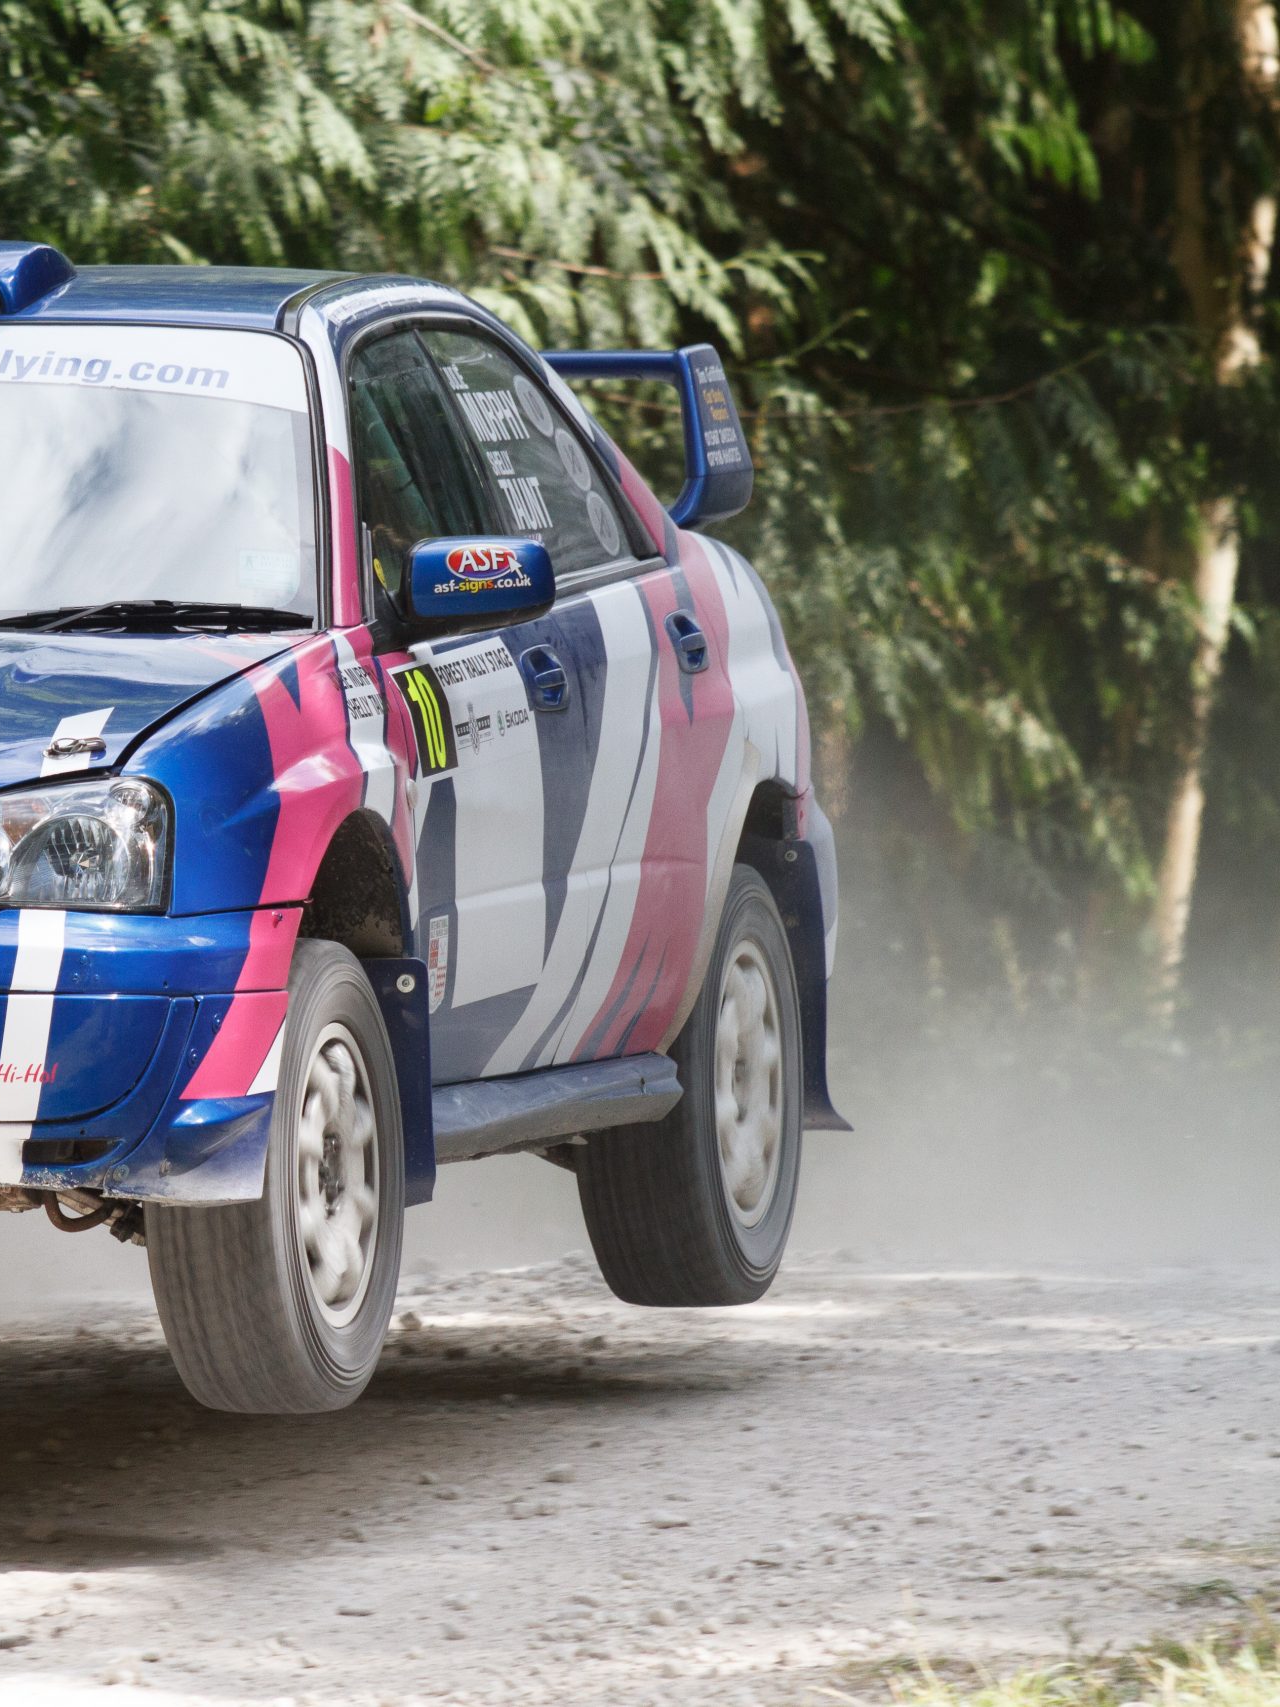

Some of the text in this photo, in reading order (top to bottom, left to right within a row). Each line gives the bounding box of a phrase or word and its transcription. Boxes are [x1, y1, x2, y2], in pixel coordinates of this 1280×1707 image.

[456, 390, 530, 442] MURPHY
[486, 450, 515, 476] SHELLY
[498, 476, 553, 530] TAUNT
[458, 548, 505, 573] ASF
[434, 574, 532, 594] asf-signs.co.uk
[434, 647, 513, 687] FOREST RALLY STAGE
[405, 669, 446, 769] 10
